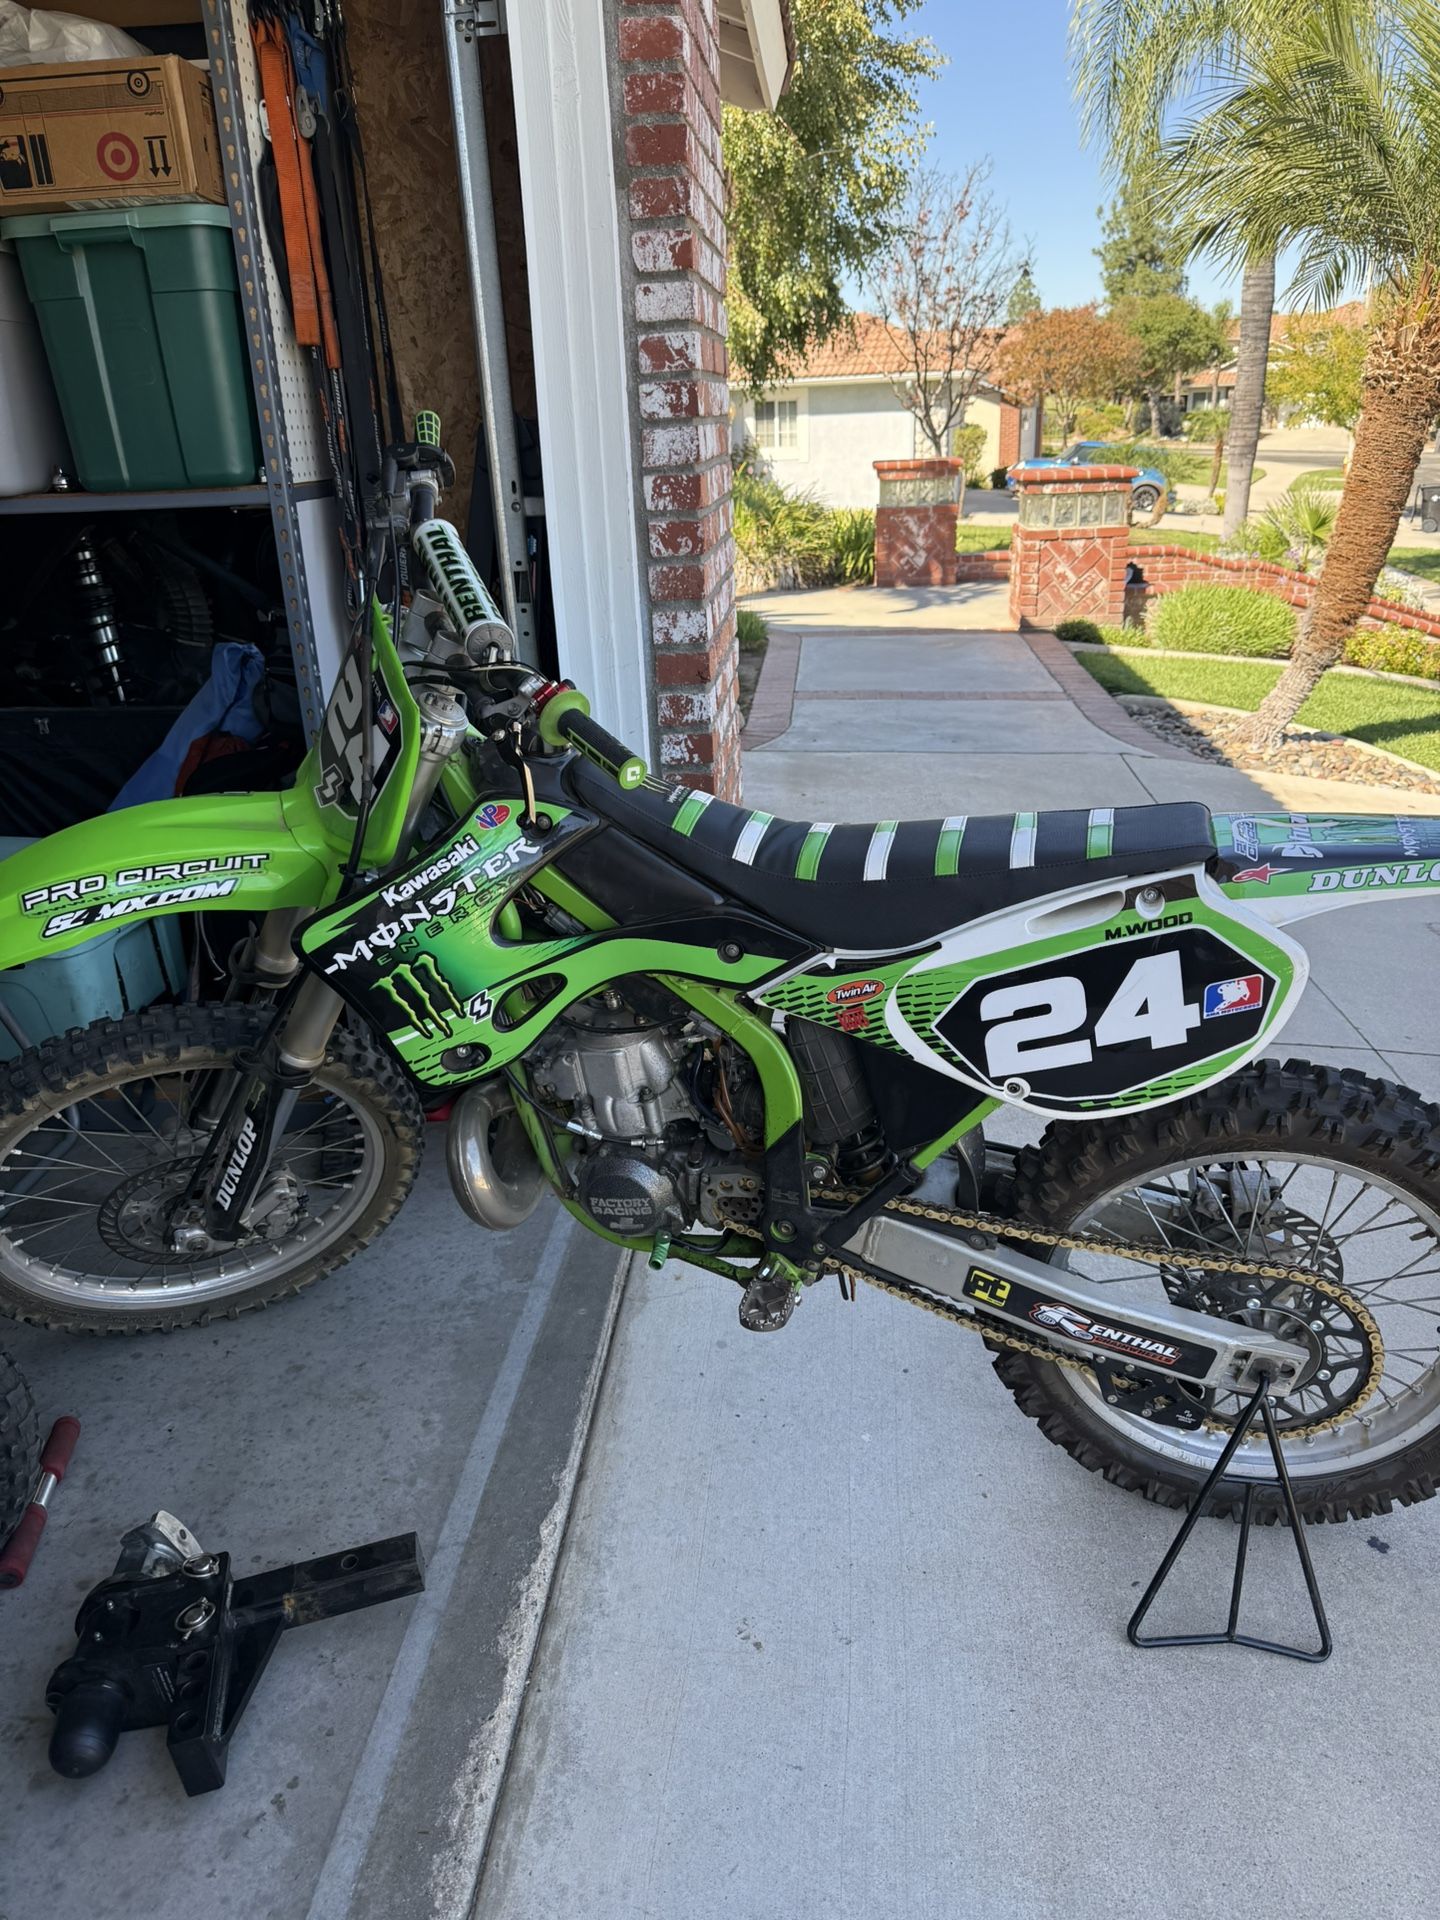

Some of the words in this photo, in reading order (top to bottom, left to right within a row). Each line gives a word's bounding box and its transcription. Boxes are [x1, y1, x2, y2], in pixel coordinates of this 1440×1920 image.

[425, 523, 488, 624] RENTHAL
[22, 875, 106, 912] PRO
[115, 853, 270, 887] CIRCUIT
[379, 833, 482, 908] Kawasaki
[1104, 911, 1194, 941] M.WOOD
[835, 987, 861, 1001] Twin
[862, 982, 878, 995] Air
[979, 950, 1202, 1079] 24
[216, 1115, 258, 1211] DUNLOP
[589, 1197, 651, 1208] FACTORY
[591, 1206, 653, 1216] RACING
